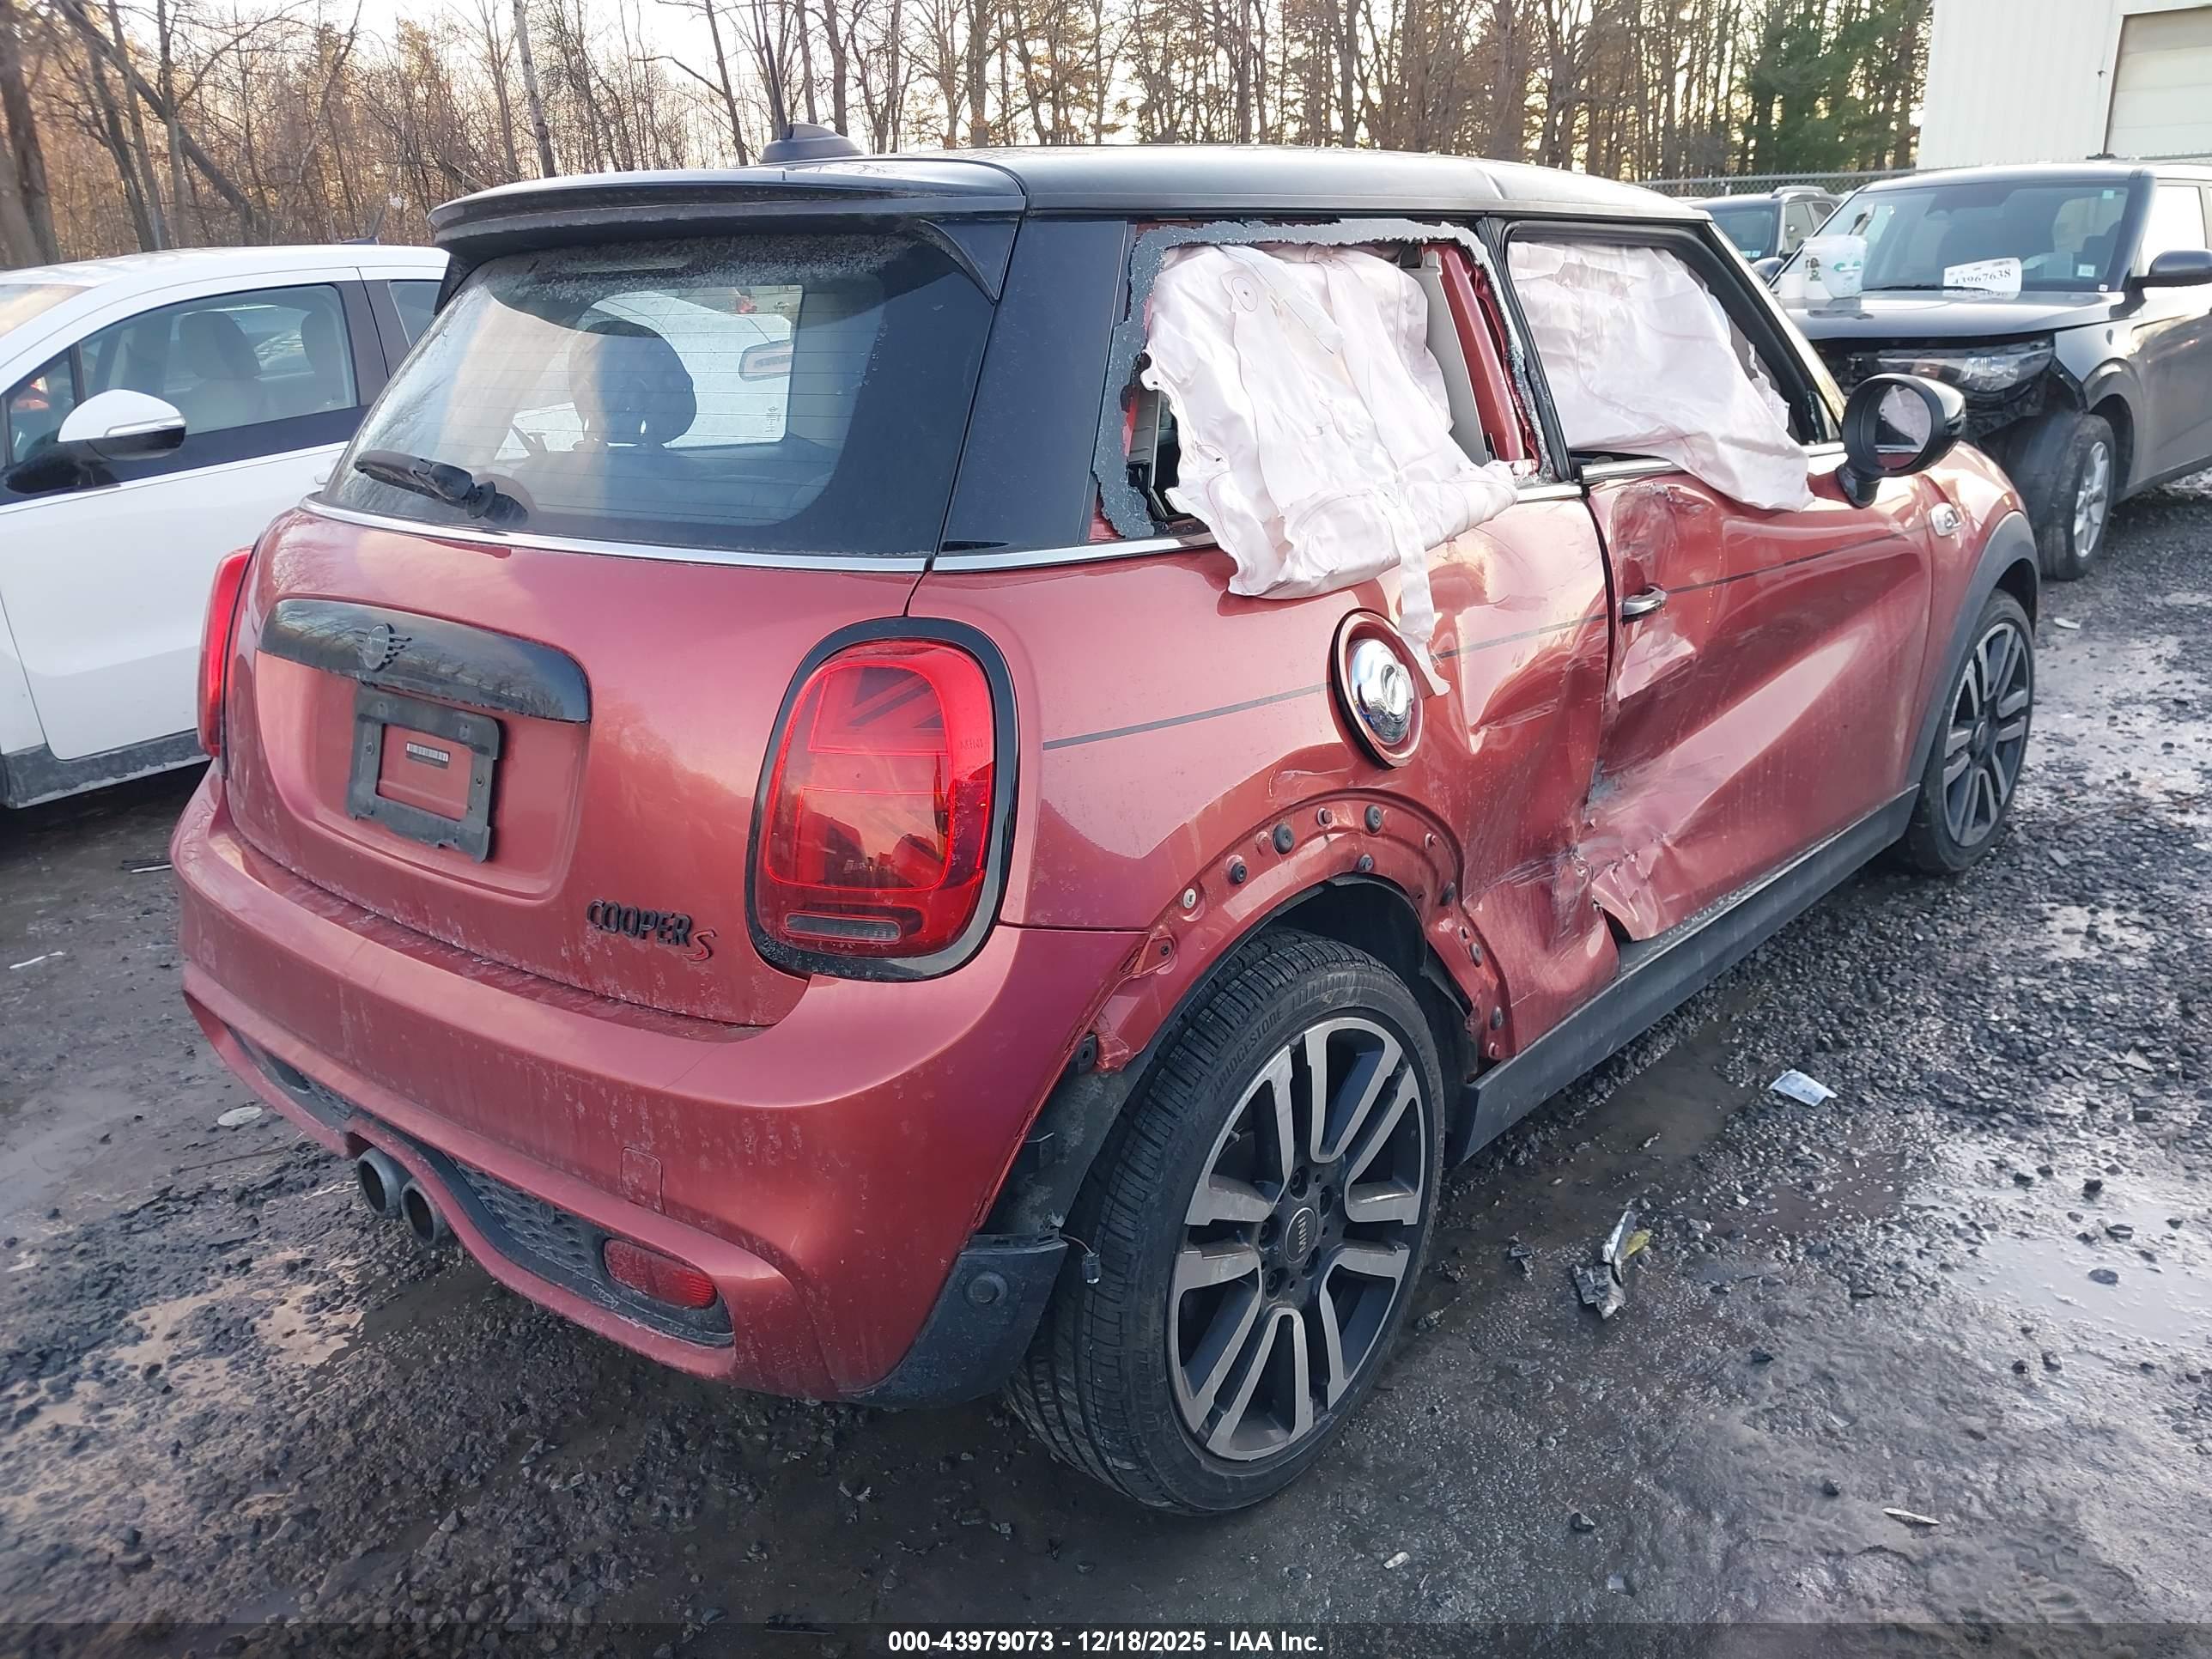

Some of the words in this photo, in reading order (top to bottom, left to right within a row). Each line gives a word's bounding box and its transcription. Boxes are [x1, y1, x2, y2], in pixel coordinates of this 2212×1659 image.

[960, 738, 983, 750] MINI
[587, 899, 692, 947] COOPER
[683, 929, 717, 963] S
[1297, 1215, 1307, 1254] MINI
